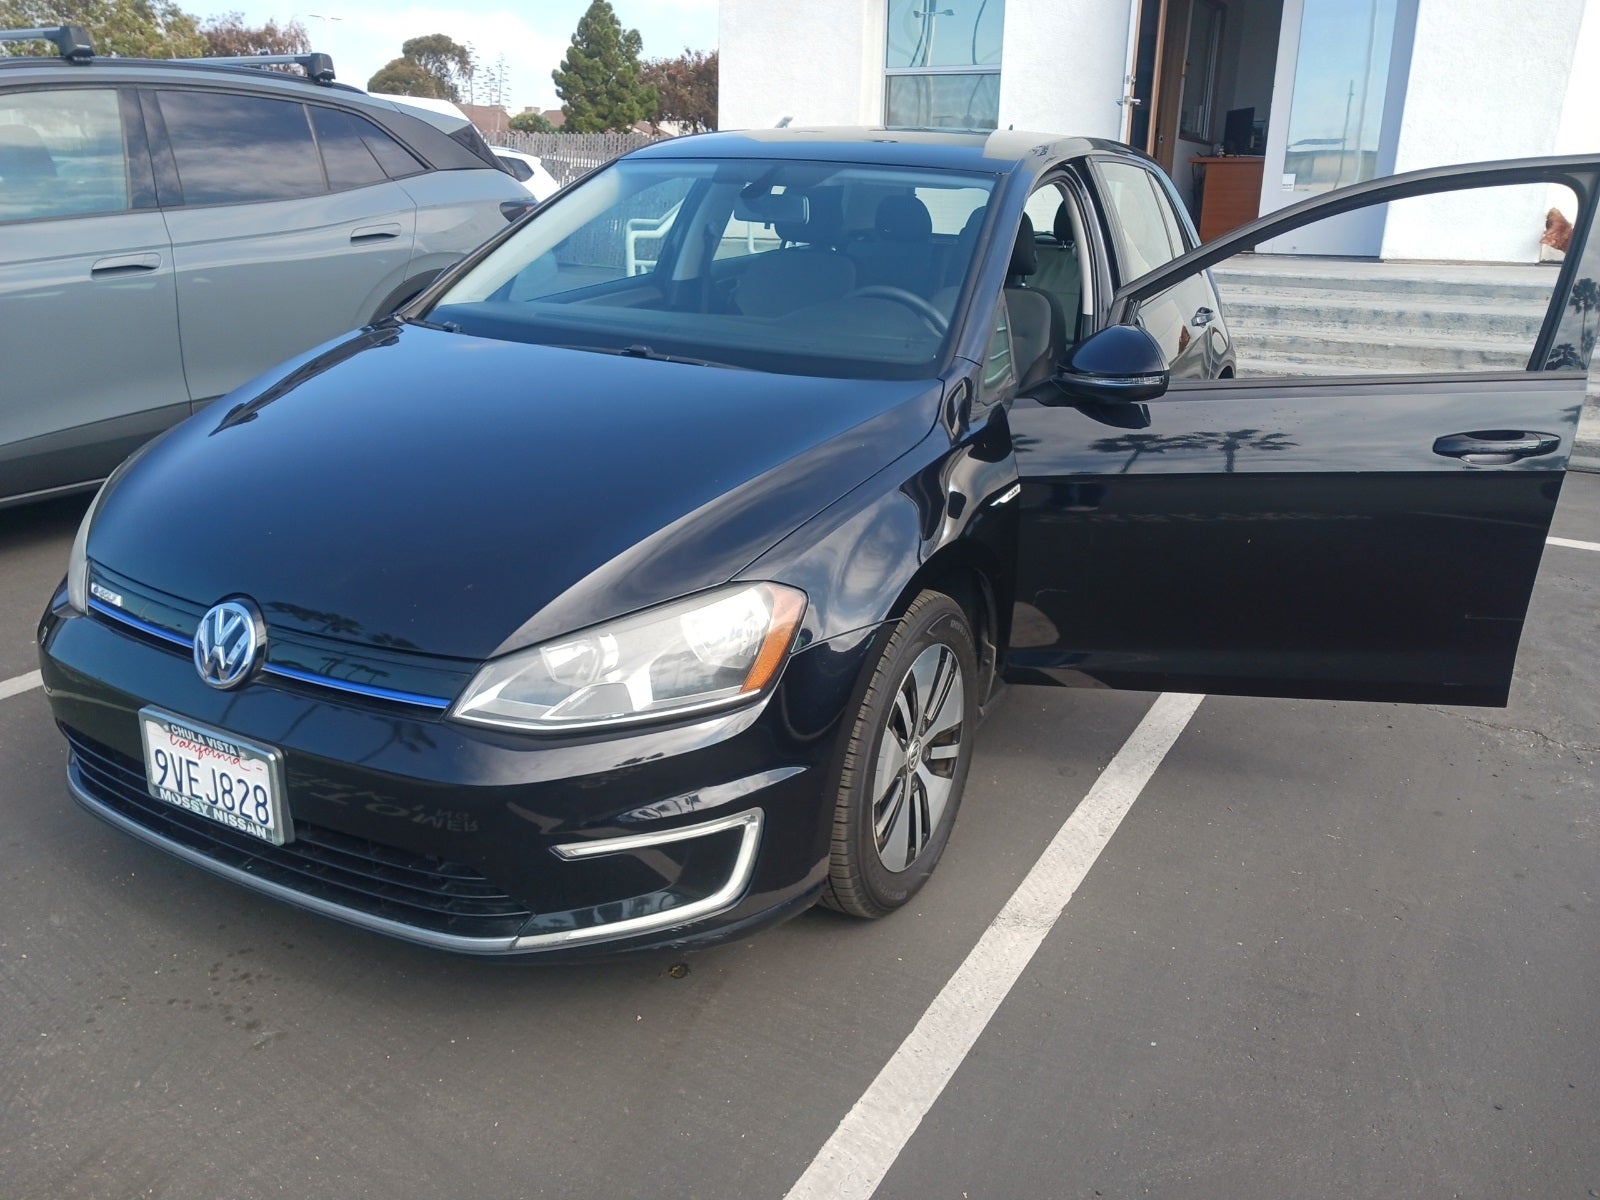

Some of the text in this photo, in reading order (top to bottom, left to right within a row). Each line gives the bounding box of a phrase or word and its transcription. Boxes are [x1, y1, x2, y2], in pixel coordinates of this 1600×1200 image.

[170, 724, 236, 756] CHULA VISTA
[170, 733, 250, 771] California
[154, 748, 268, 825] 9VEJ828
[160, 787, 266, 839] MOSSY NISSAN
